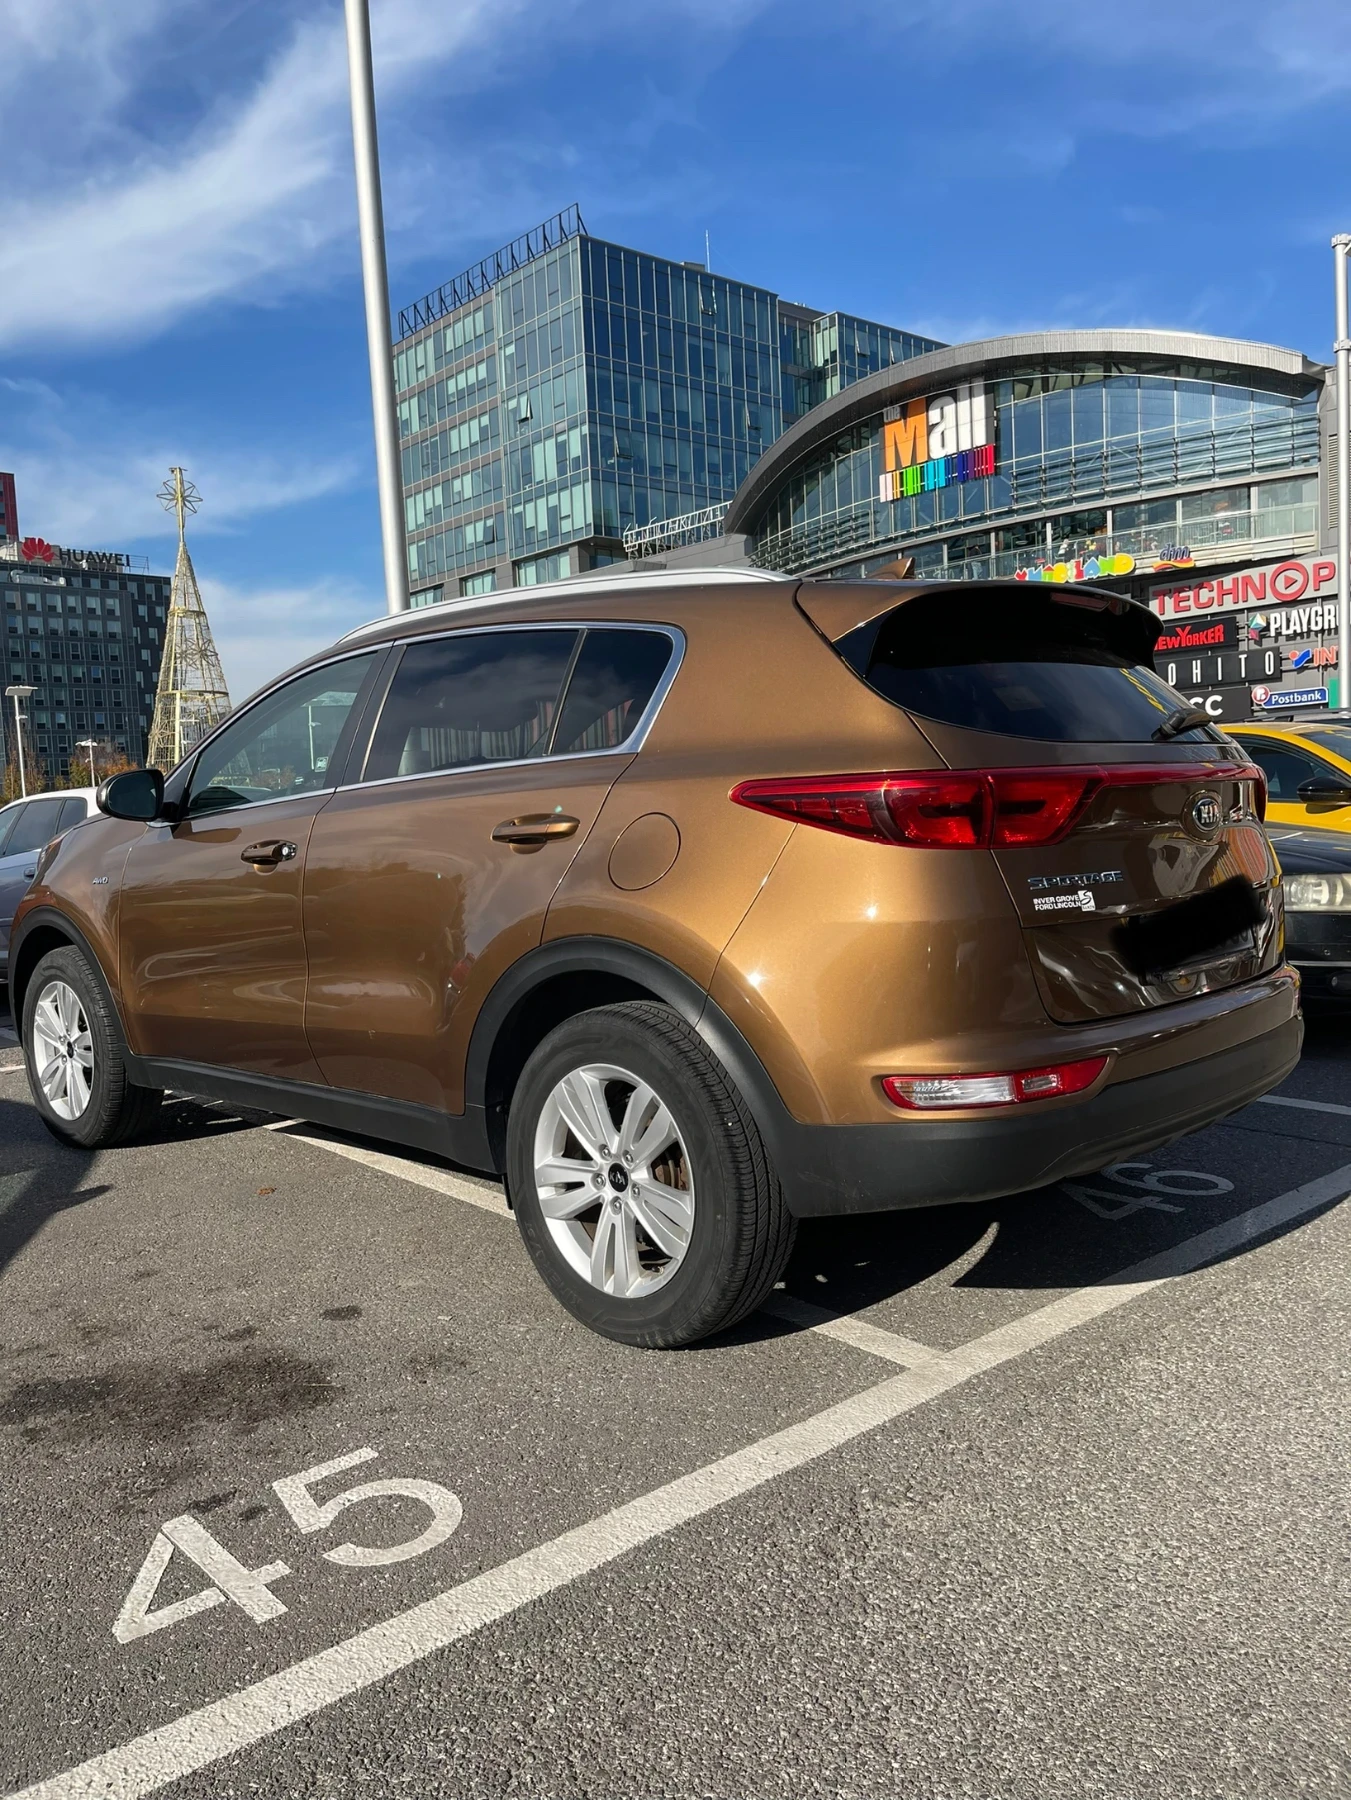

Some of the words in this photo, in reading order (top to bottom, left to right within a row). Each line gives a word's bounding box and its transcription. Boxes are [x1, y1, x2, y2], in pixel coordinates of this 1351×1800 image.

[884, 377, 986, 472] Mall
[59, 547, 131, 567] HUAWEI
[1159, 543, 1192, 561] dm
[1152, 561, 1337, 616] TECHNOP
[1269, 604, 1339, 637] PLAYGR
[1167, 650, 1274, 687] OHITO
[1271, 690, 1322, 705] Postbank
[1033, 896, 1055, 905] INVER
[1055, 894, 1079, 903] GROVE
[1034, 903, 1053, 911] FORD
[1053, 901, 1081, 909] LINCOLN
[1061, 1162, 1235, 1221] 46
[112, 1446, 463, 1644] 45
